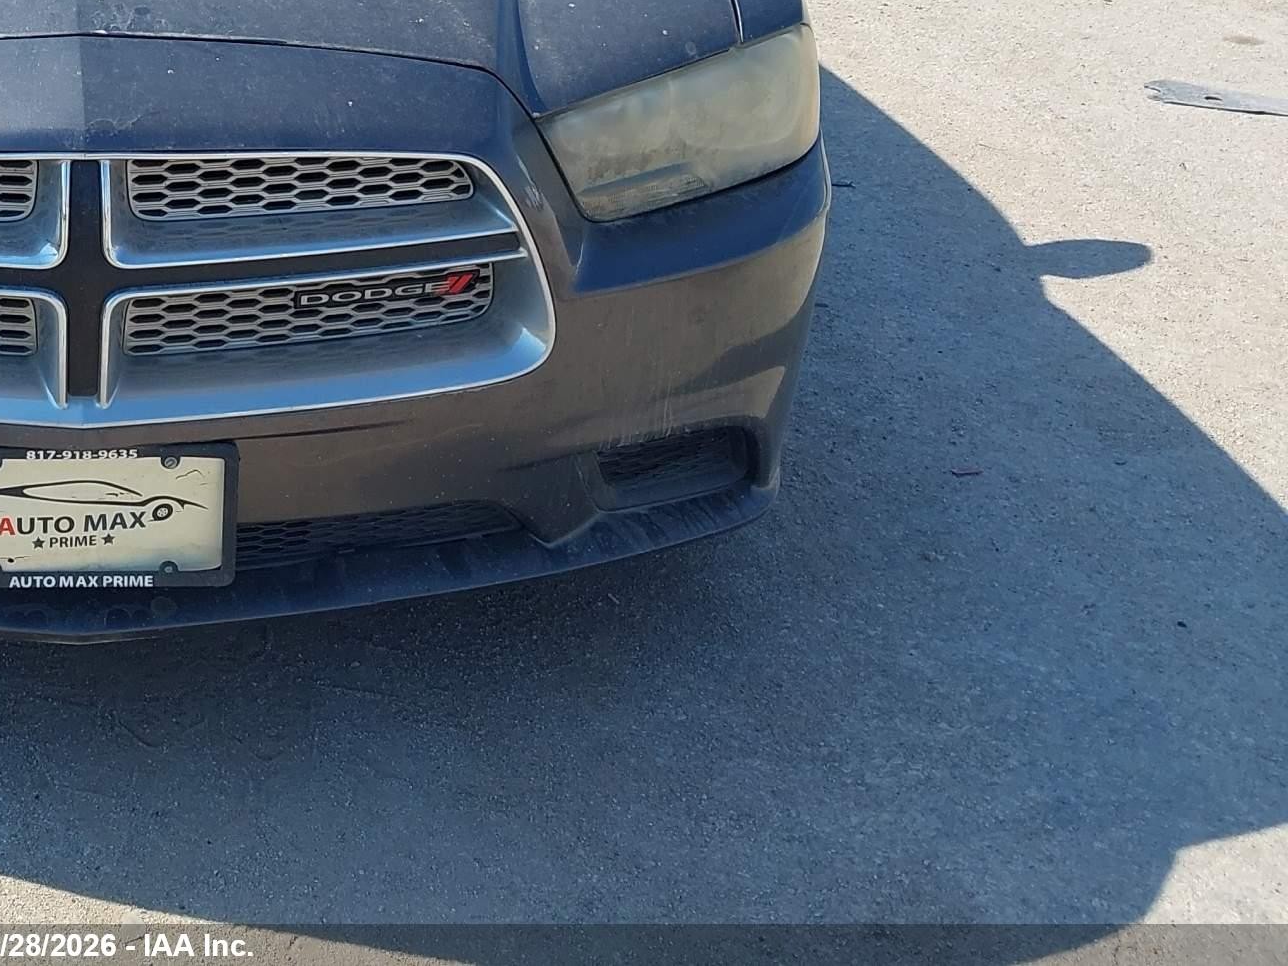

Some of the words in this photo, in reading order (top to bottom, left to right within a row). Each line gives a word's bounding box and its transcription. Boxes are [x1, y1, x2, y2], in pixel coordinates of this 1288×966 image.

[300, 282, 450, 306] DODGE
[25, 449, 139, 460] 817-918-9635
[83, 511, 147, 533] MAX
[49, 535, 97, 548] PRIME
[9, 575, 56, 588] AUTO
[58, 575, 101, 588] MAX
[102, 575, 154, 587] PRIME
